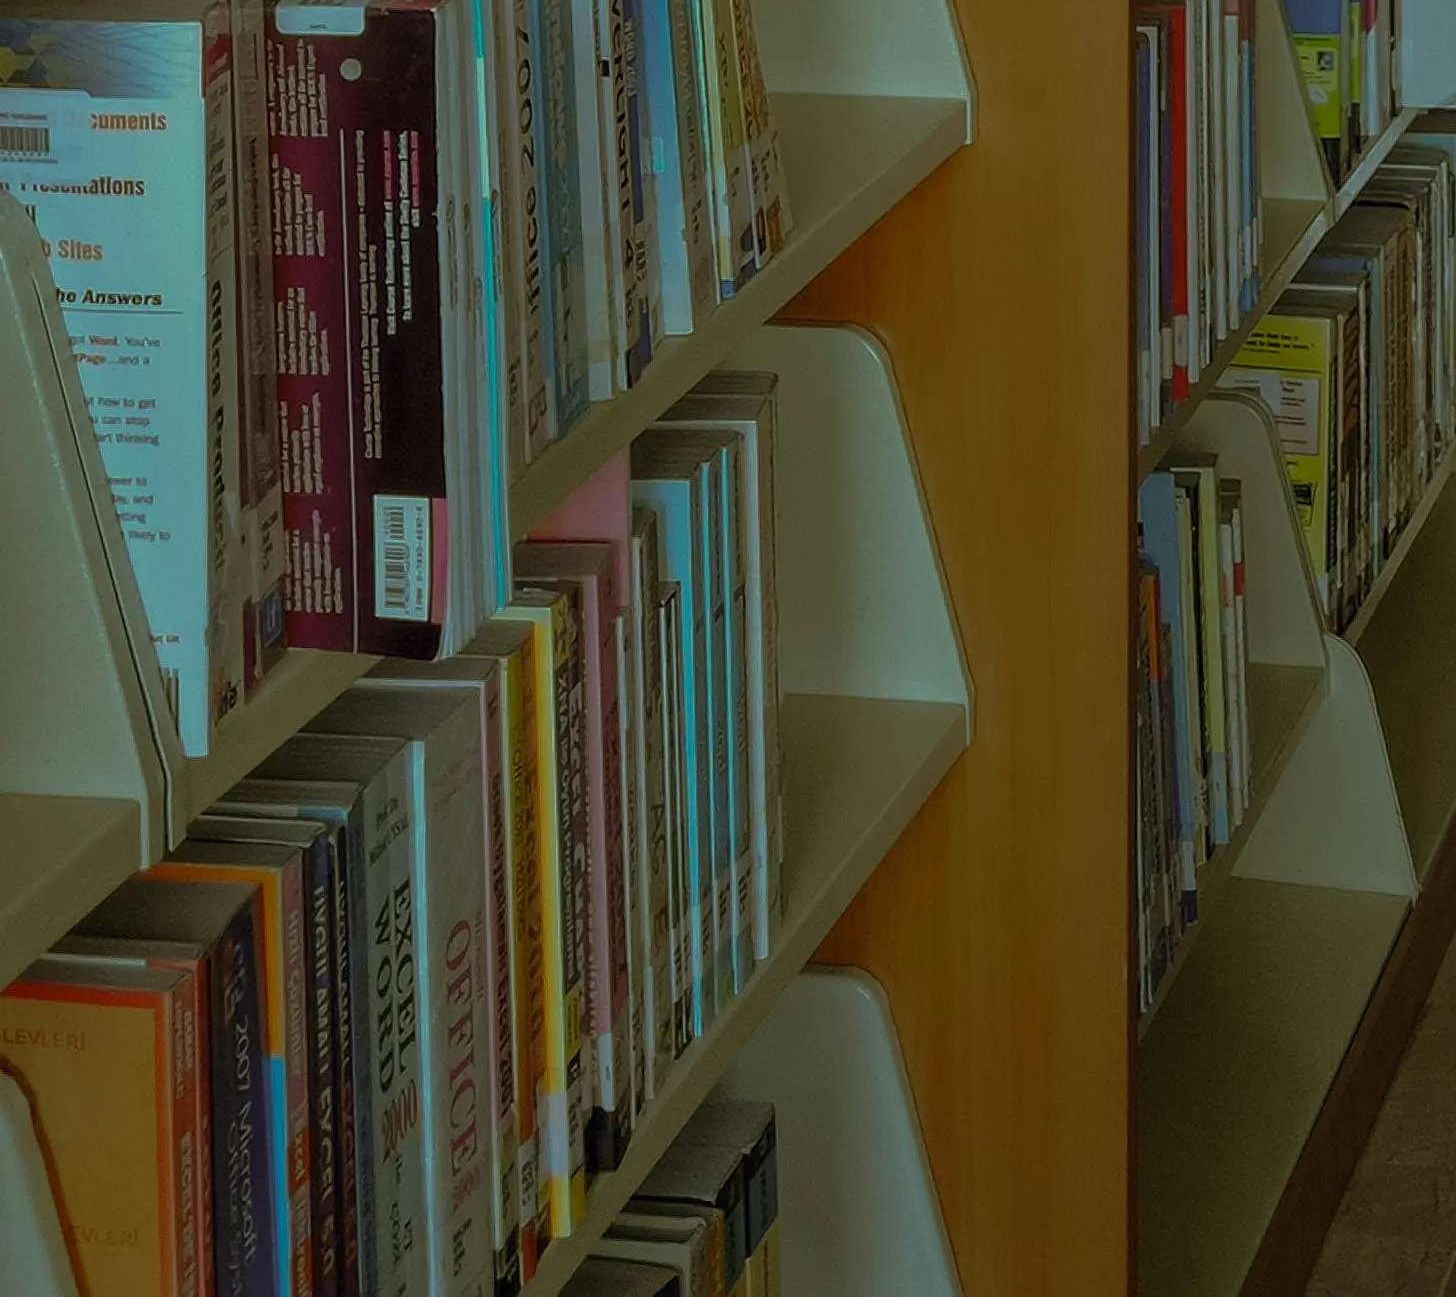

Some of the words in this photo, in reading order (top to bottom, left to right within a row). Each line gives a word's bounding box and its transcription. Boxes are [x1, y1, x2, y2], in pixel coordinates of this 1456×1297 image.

[91, 112, 168, 131] uments
[515, 26, 537, 172] 2007
[58, 238, 104, 262] Sites
[82, 288, 163, 306] Answers
[210, 278, 225, 396] Office
[557, 671, 569, 733] XNA
[561, 772, 573, 829] Oyun
[312, 884, 331, 1077] UYGULAMALI
[374, 898, 396, 1095] WORD
[392, 879, 417, 1079] EXCEL
[235, 1016, 251, 1092] 2007
[443, 919, 478, 1177] OFFICE
[237, 1100, 258, 1267] Microsoft
[316, 1086, 333, 1205] EXCEL
[318, 1215, 335, 1278] 5.0
